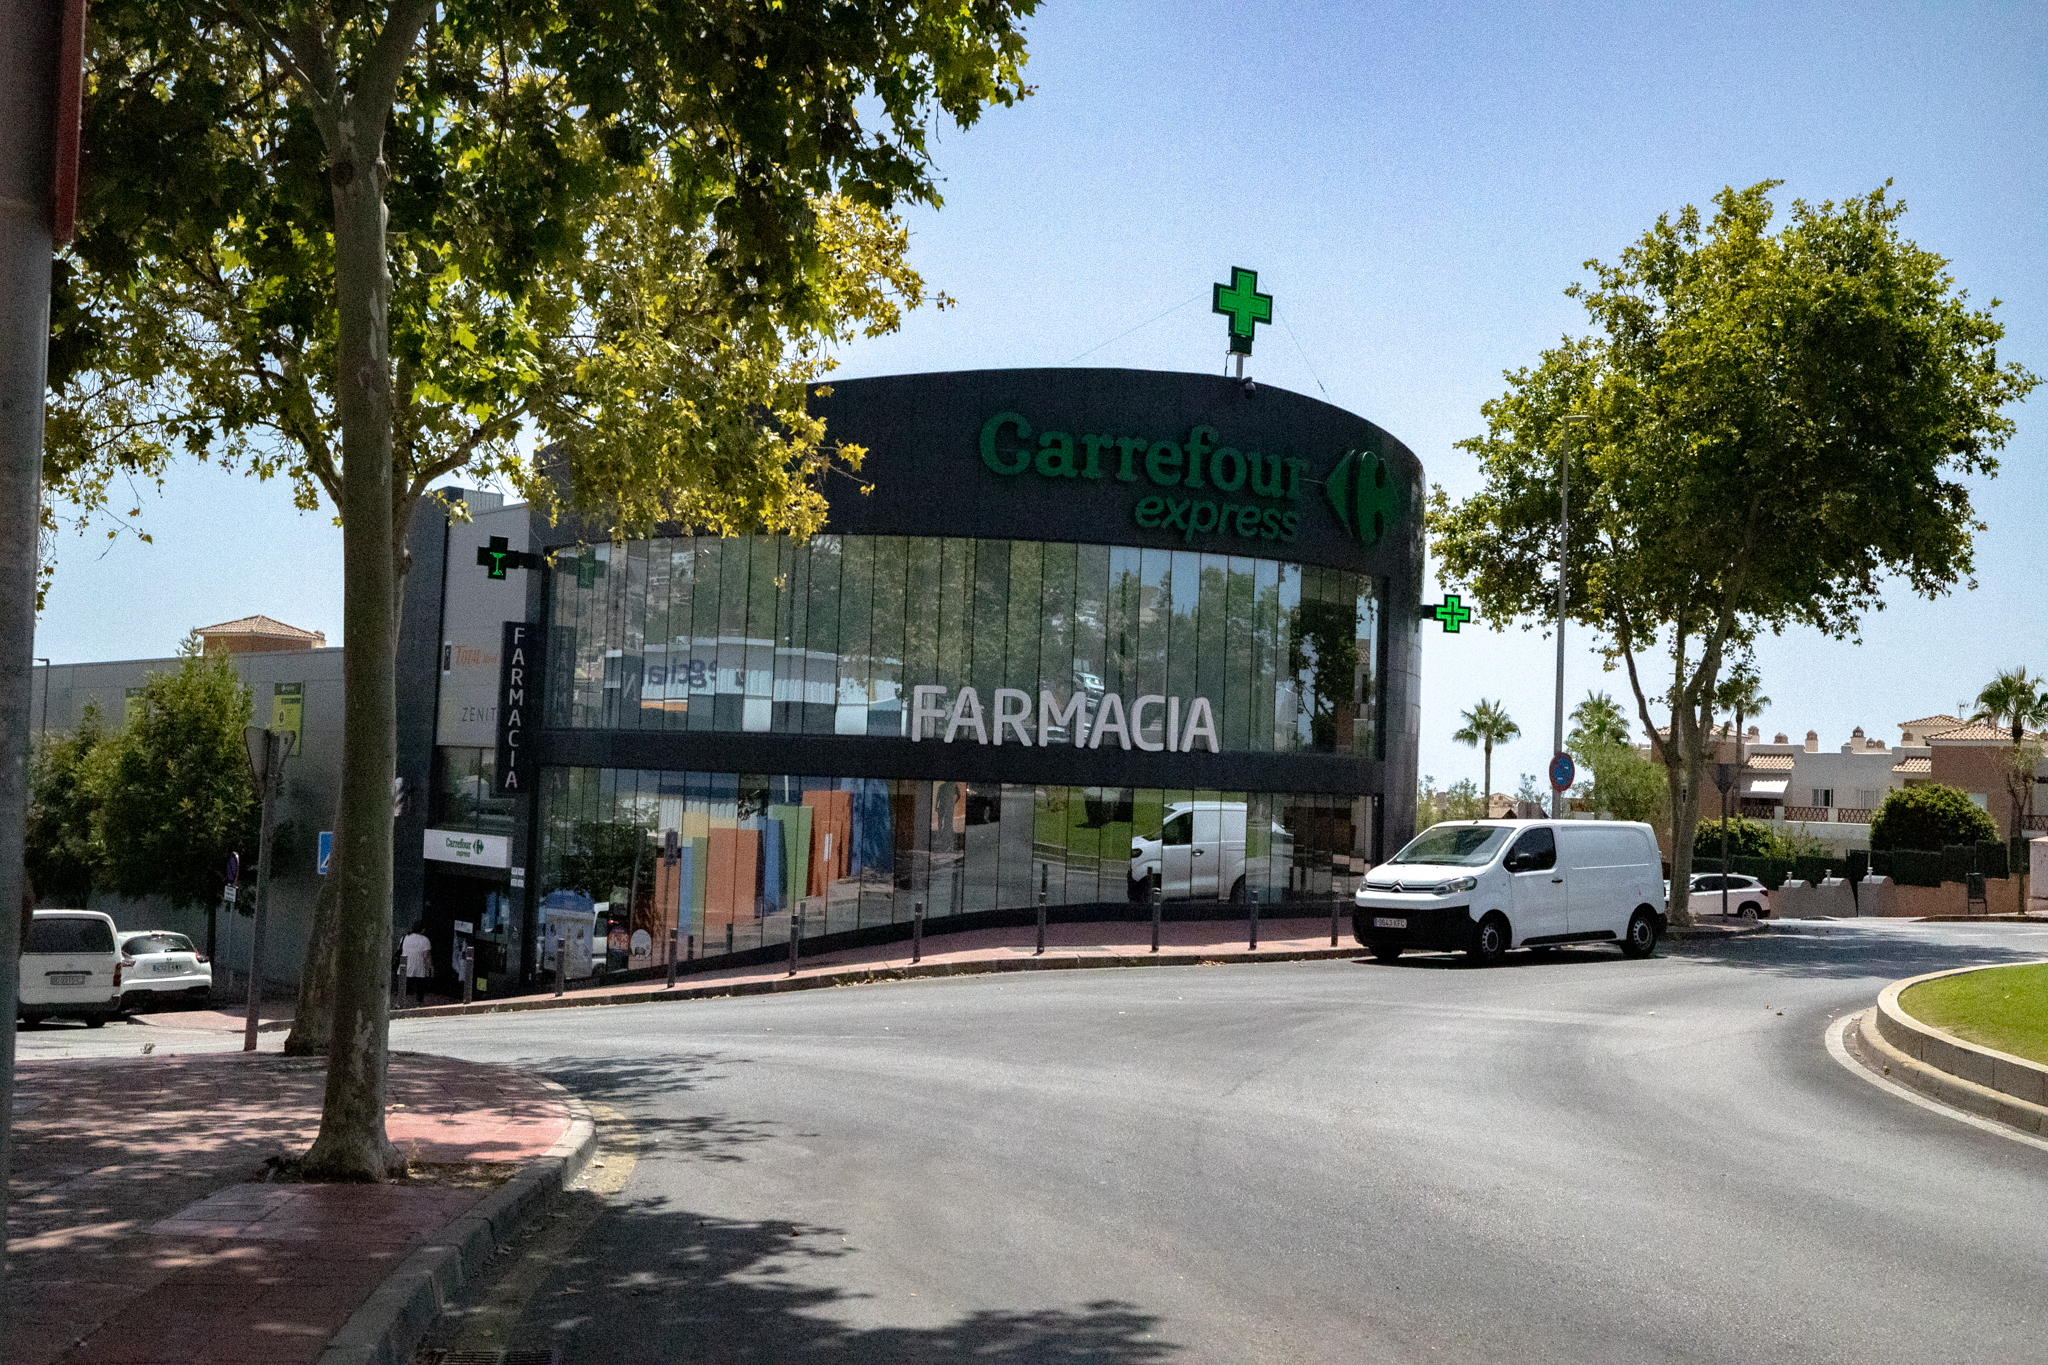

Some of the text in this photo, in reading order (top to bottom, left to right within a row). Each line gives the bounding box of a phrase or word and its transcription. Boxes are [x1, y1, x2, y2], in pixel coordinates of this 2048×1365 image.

[979, 412, 1307, 498] Carrefour
[1135, 495, 1299, 543] express
[505, 627, 525, 788] FARMACIA
[911, 685, 1220, 754] FARMACIA
[446, 837, 472, 850] Carrefour
